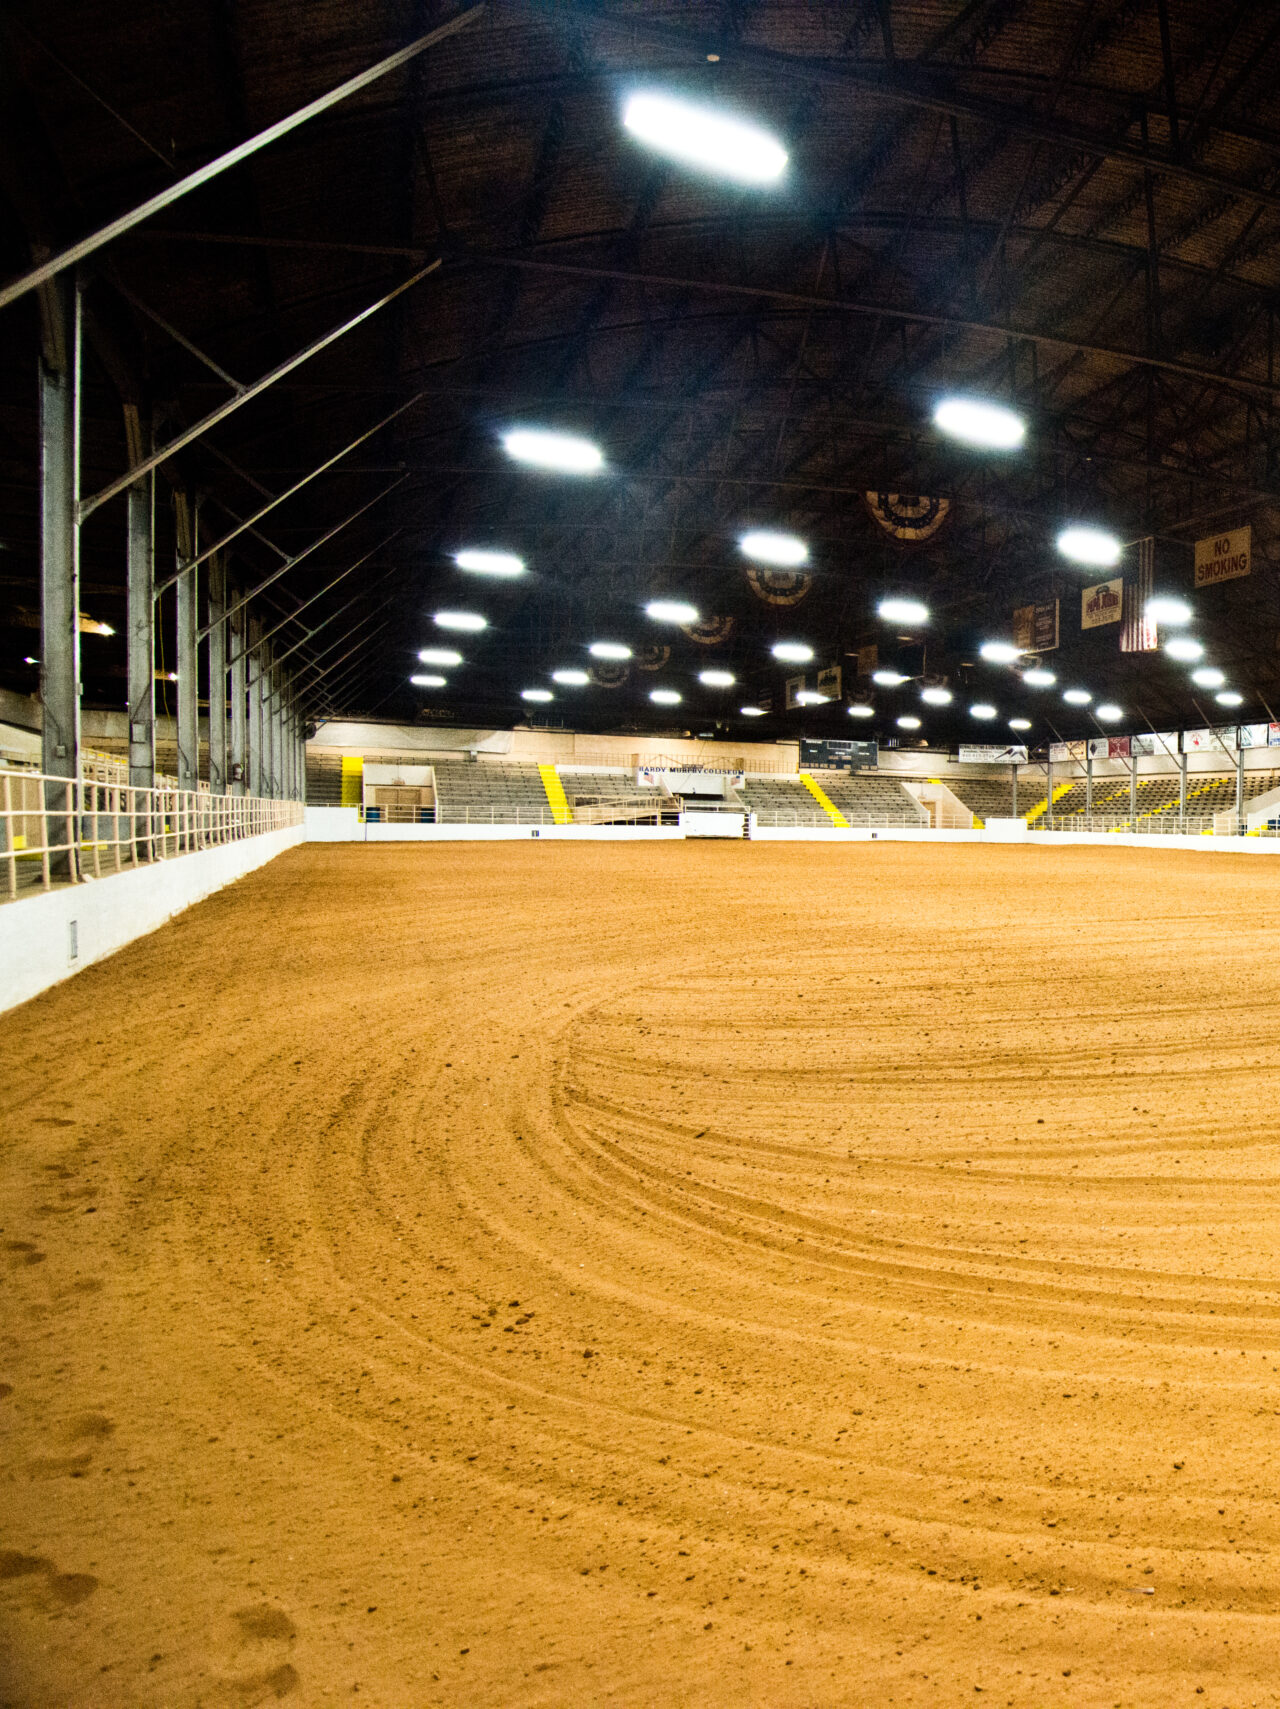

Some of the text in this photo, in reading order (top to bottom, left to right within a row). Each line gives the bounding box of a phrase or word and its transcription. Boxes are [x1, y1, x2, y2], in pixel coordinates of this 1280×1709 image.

[1214, 538, 1231, 557] NO
[1197, 553, 1248, 581] SMOKING
[703, 768, 745, 776] COLISEUM
